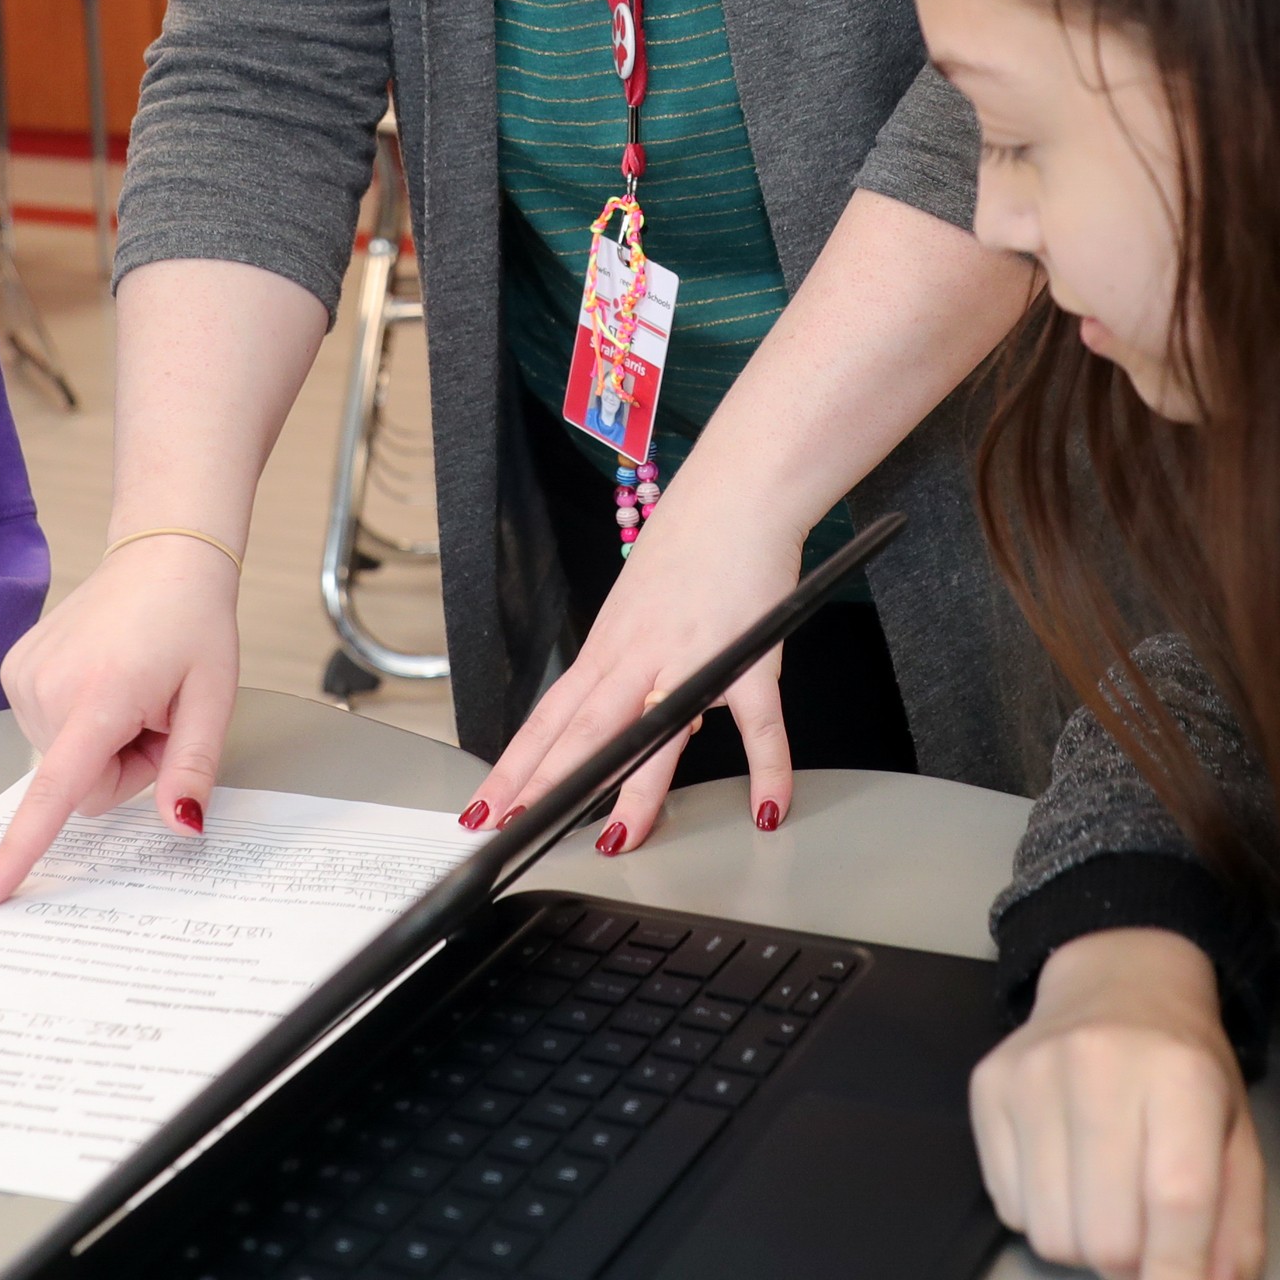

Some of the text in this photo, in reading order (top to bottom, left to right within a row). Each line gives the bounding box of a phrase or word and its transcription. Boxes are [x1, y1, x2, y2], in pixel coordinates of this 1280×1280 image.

[647, 291, 671, 310] Schools
[589, 337, 647, 377] Srah arris
